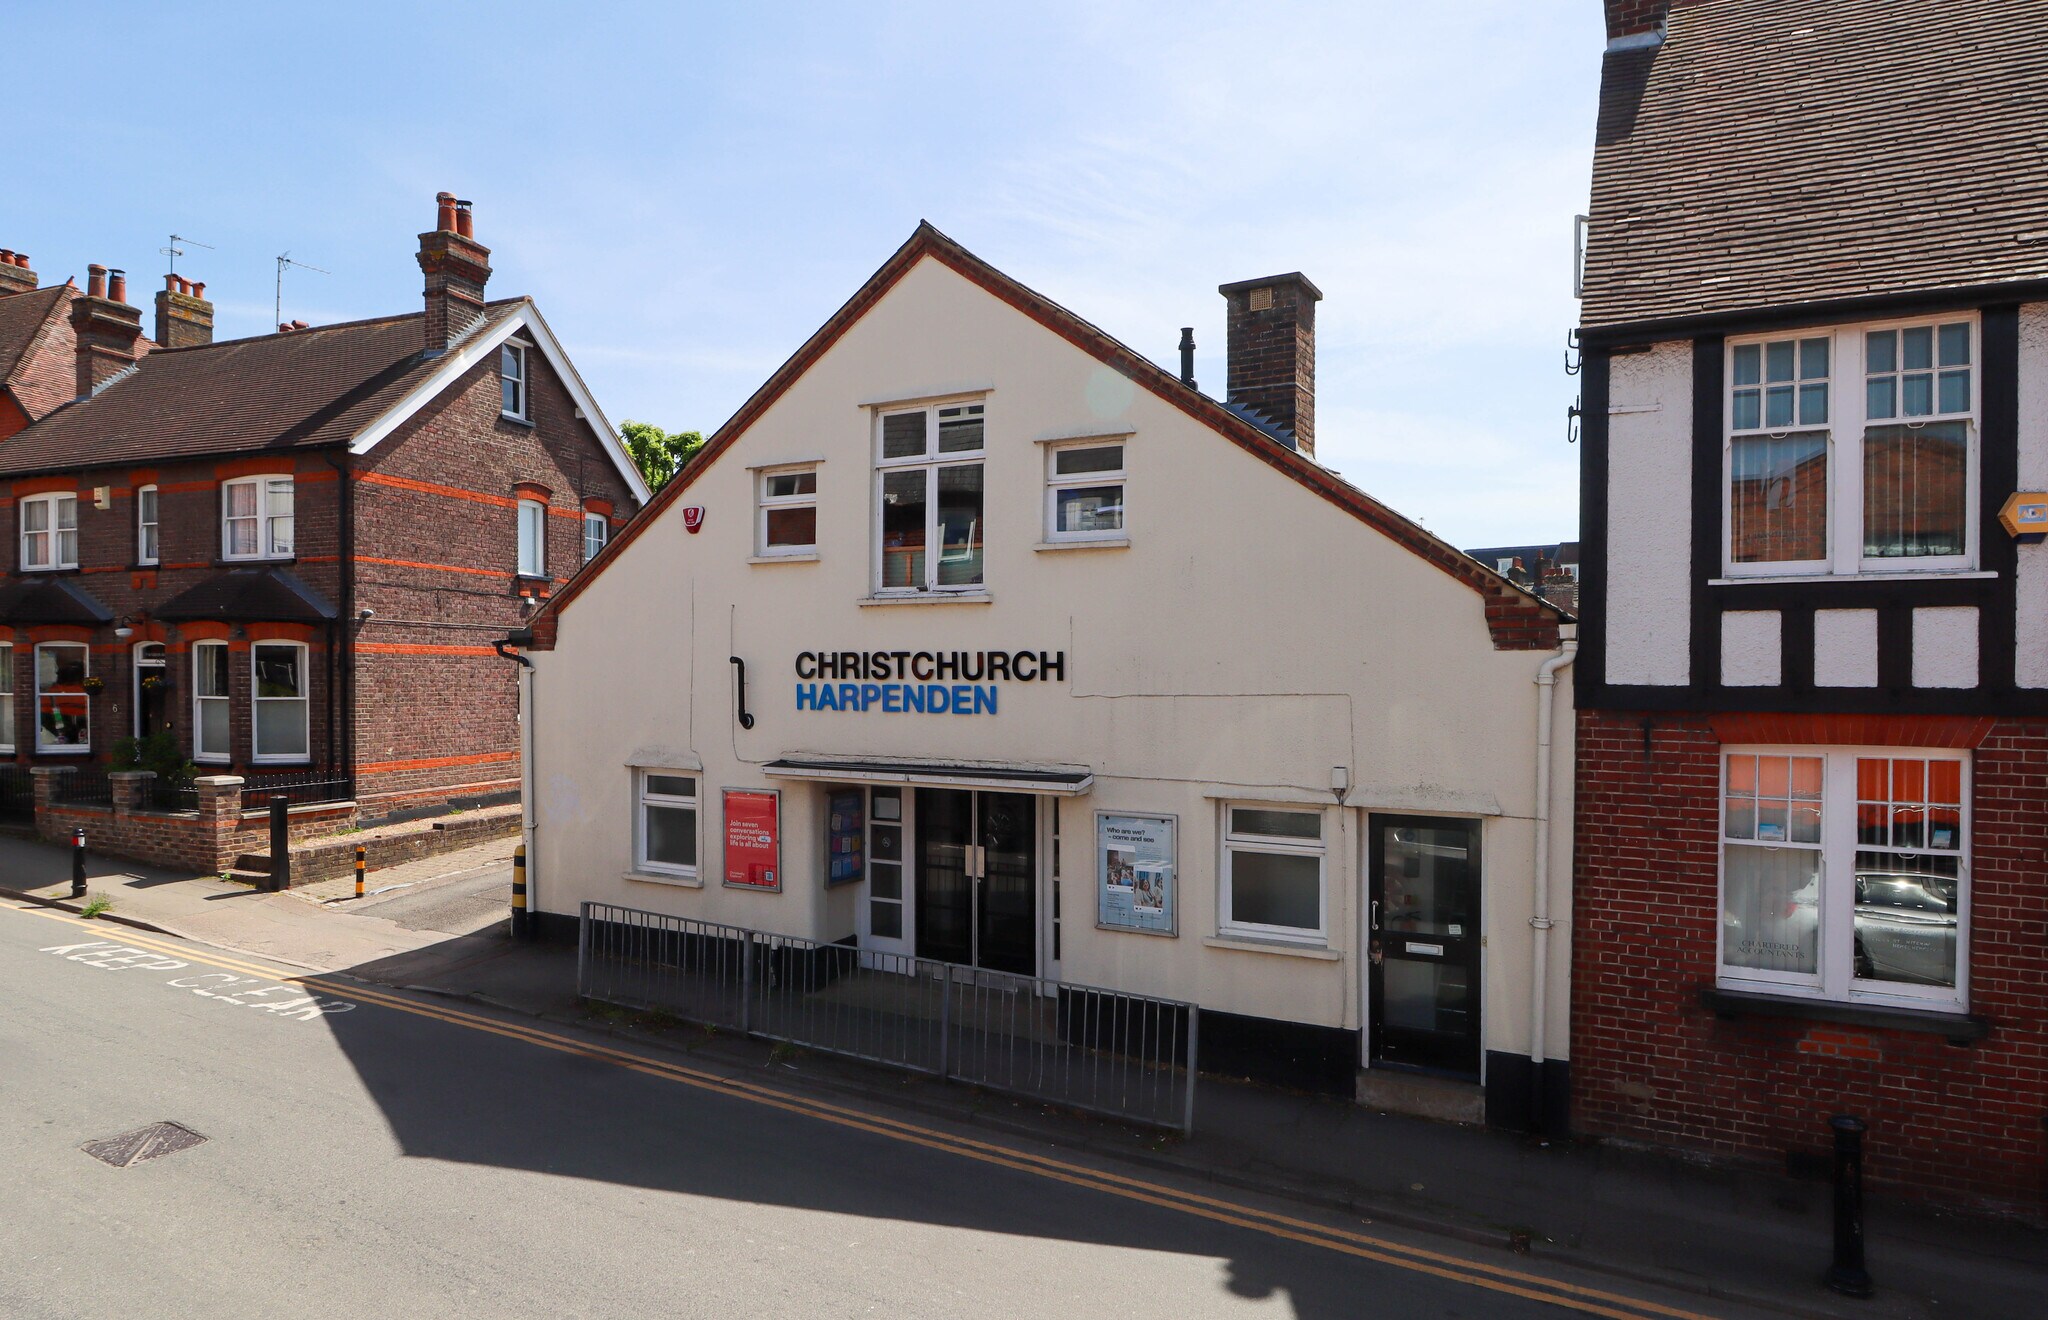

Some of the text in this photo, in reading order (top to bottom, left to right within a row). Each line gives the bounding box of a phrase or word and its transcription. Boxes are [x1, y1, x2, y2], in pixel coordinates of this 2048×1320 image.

[795, 651, 1064, 682] CHRISTCHURCH
[796, 683, 997, 715] HARPENDEN
[730, 828, 770, 836] conversations
[730, 834, 757, 842] exploring
[1736, 946, 1806, 959] ACCOUNTANTS
[1741, 940, 1799, 952] CHARTERED
[39, 941, 357, 1022] KEEP CLEAR
